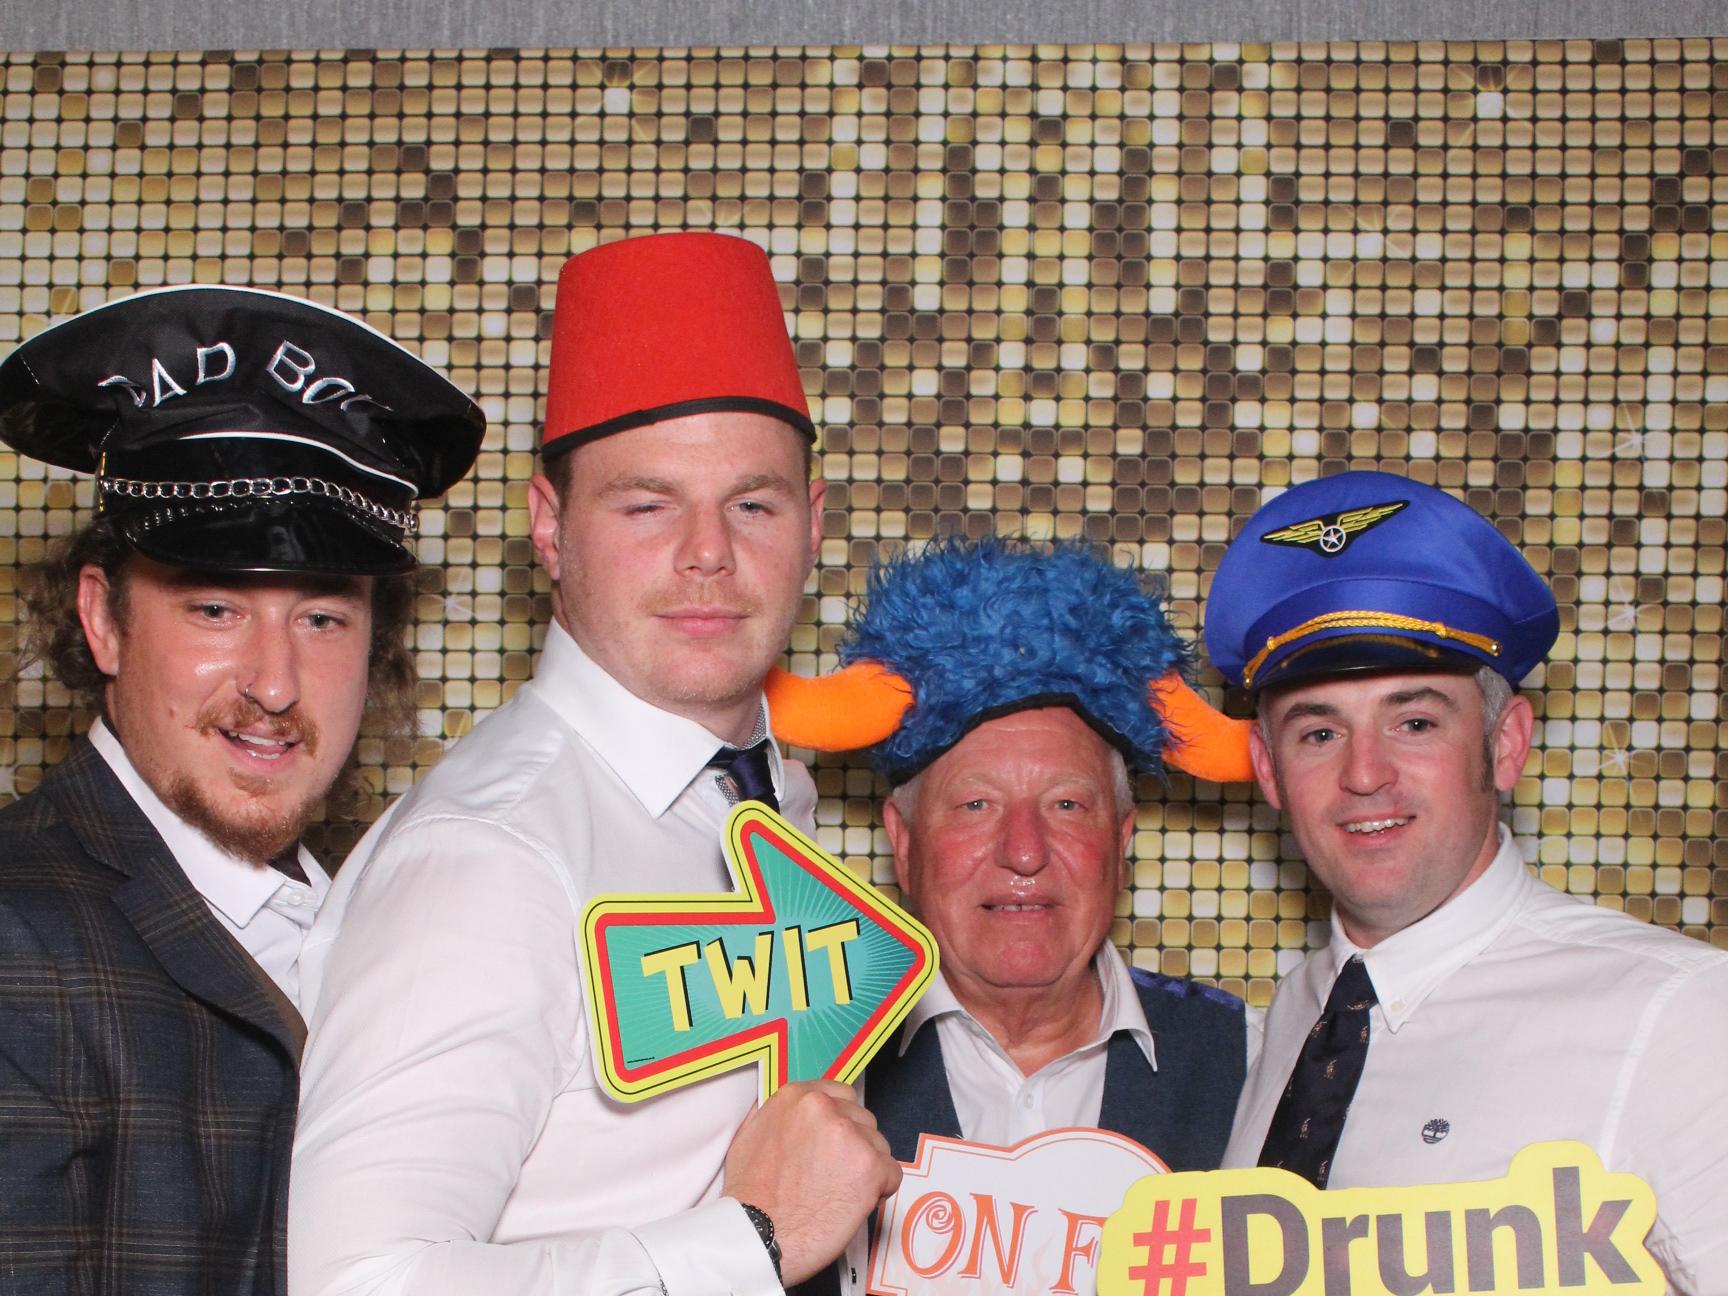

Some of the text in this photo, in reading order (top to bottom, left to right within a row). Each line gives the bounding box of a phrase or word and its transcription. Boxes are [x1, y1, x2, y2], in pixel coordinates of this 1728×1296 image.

[640, 918, 861, 1032] TWIT
[901, 1190, 1108, 1296] ON F
